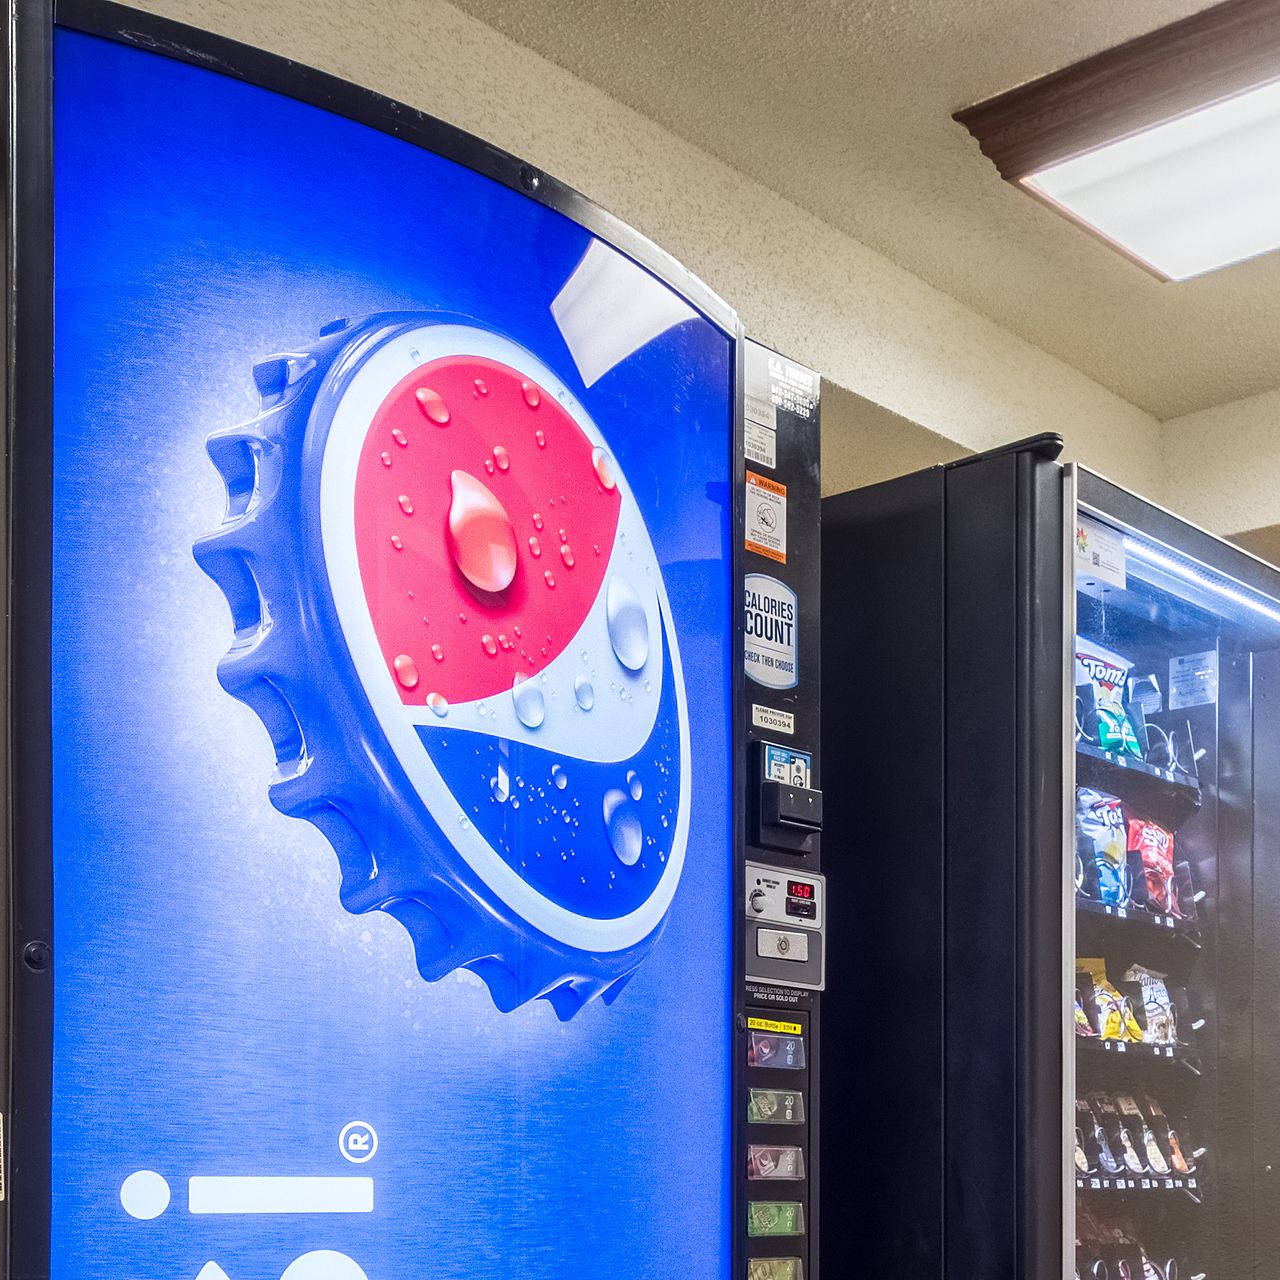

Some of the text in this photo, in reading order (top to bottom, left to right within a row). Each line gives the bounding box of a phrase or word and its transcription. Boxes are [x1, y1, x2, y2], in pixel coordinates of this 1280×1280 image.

[758, 479, 785, 495] WARNING
[745, 589, 793, 621] CALORIES
[745, 609, 793, 646] COUNT
[745, 650, 794, 673] CHECK THEN CHOOSE
[755, 706, 769, 714] PLEASE
[760, 715, 791, 729] 1030394
[792, 884, 811, 898] 1.50
[753, 992, 768, 1000] PRICE
[768, 993, 776, 1001] OR
[788, 995, 799, 1003] OUT
[758, 986, 784, 996] SELECTION
[784, 988, 791, 996] TO
[790, 989, 809, 998] DISPLAY
[786, 1041, 796, 1050] 20
[785, 1096, 794, 1106] 20
